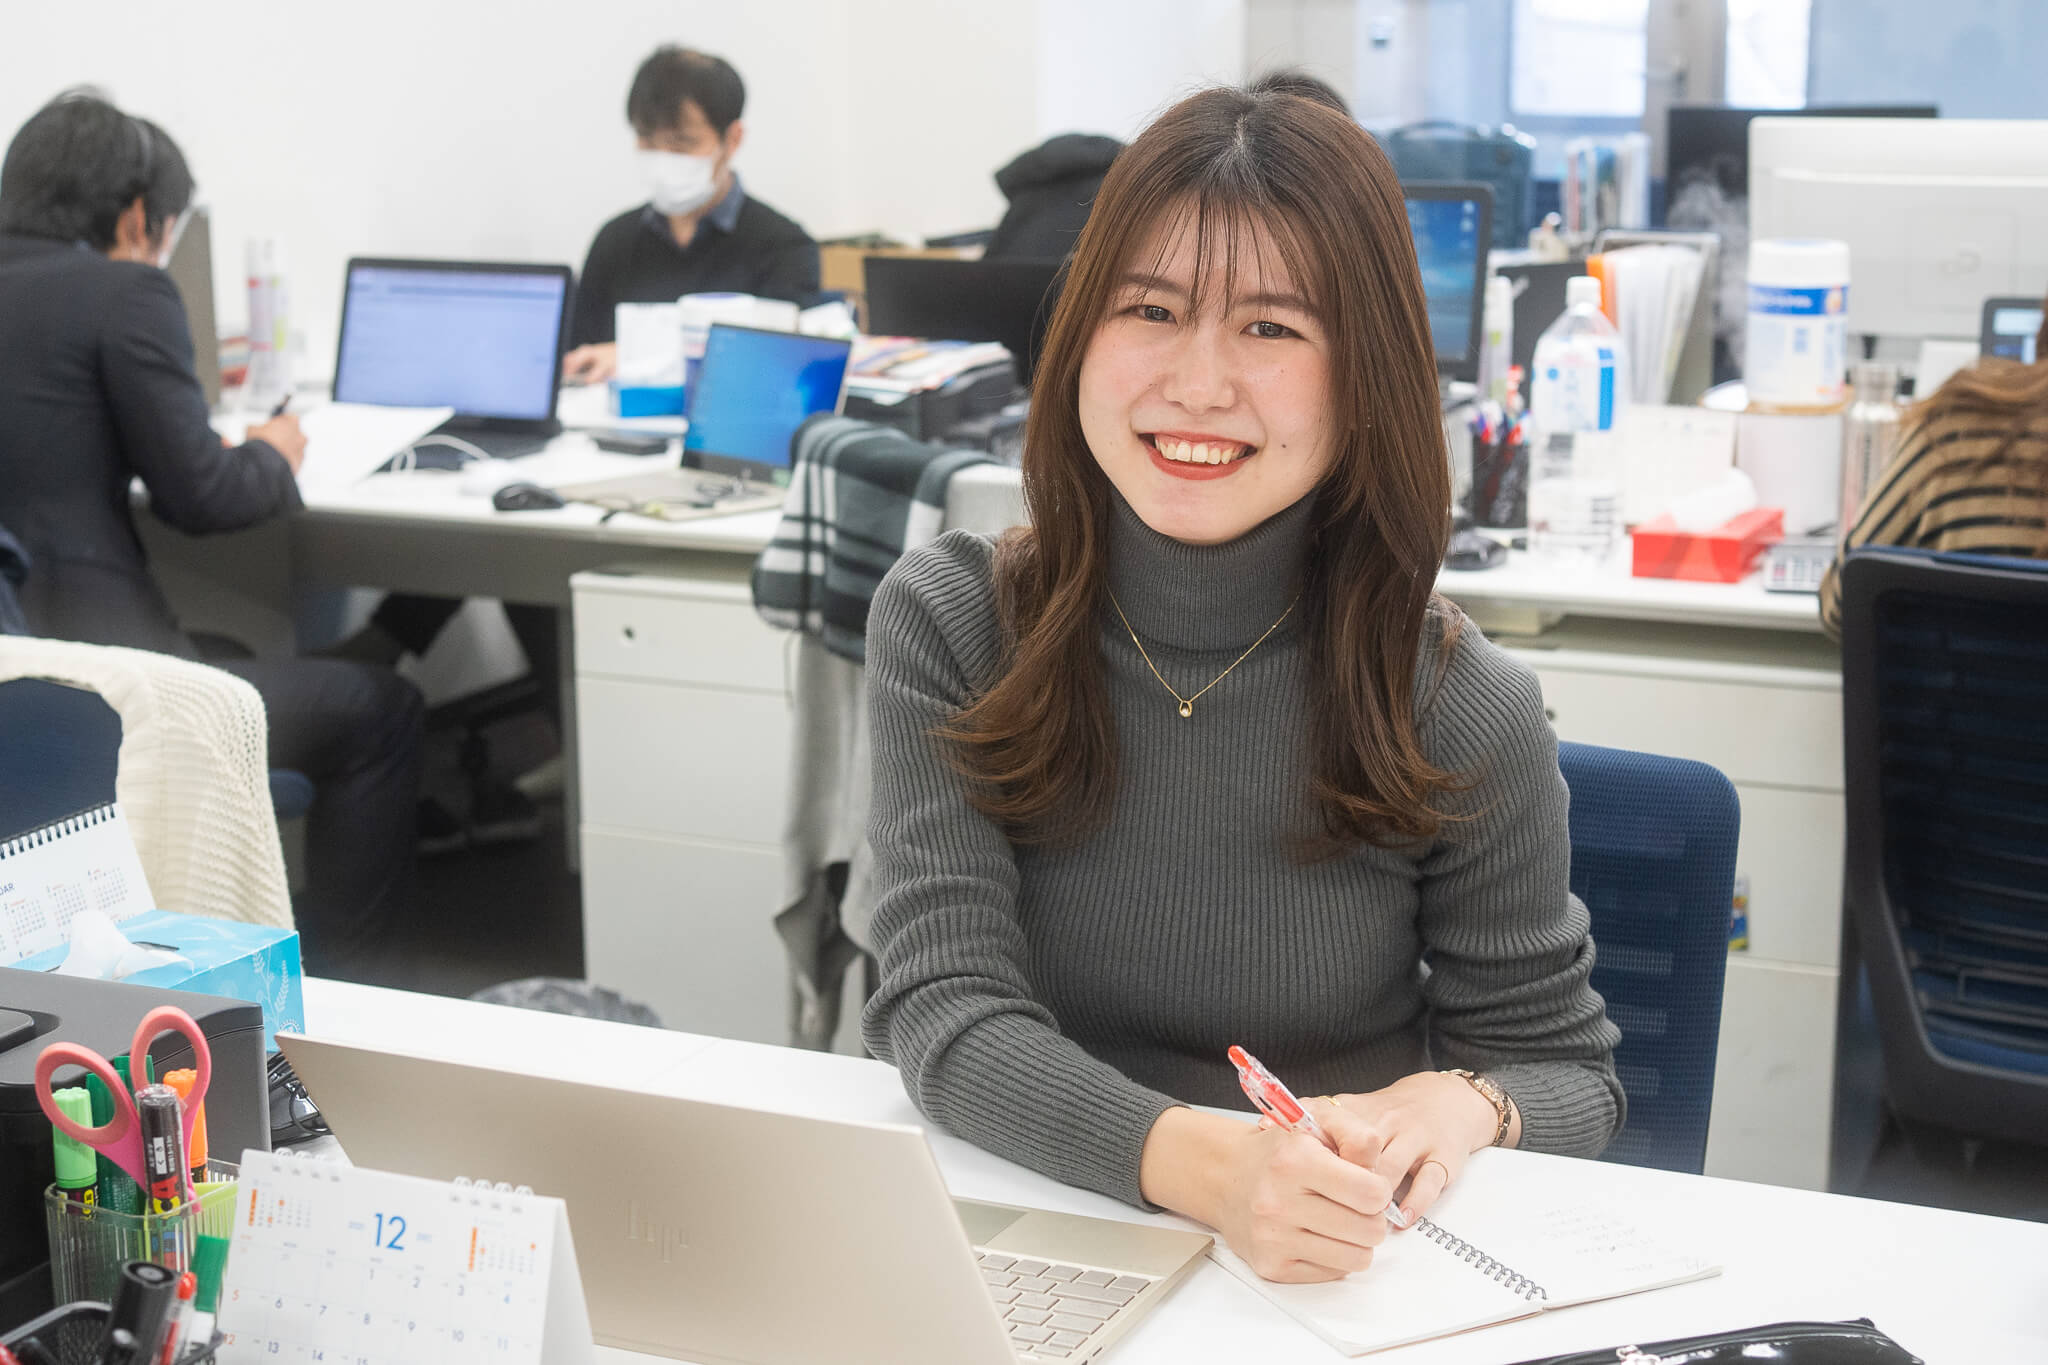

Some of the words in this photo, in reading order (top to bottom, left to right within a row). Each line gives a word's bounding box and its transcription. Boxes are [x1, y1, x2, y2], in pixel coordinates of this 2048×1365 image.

[374, 1213, 407, 1251] 12
[231, 1289, 240, 1301] 5
[274, 1298, 283, 1309] 6
[318, 1305, 327, 1316] 7
[363, 1313, 371, 1325] 8
[407, 1321, 416, 1332] 9
[452, 1330, 464, 1342] 10
[268, 1341, 280, 1354] 13
[312, 1349, 324, 1361] 14
